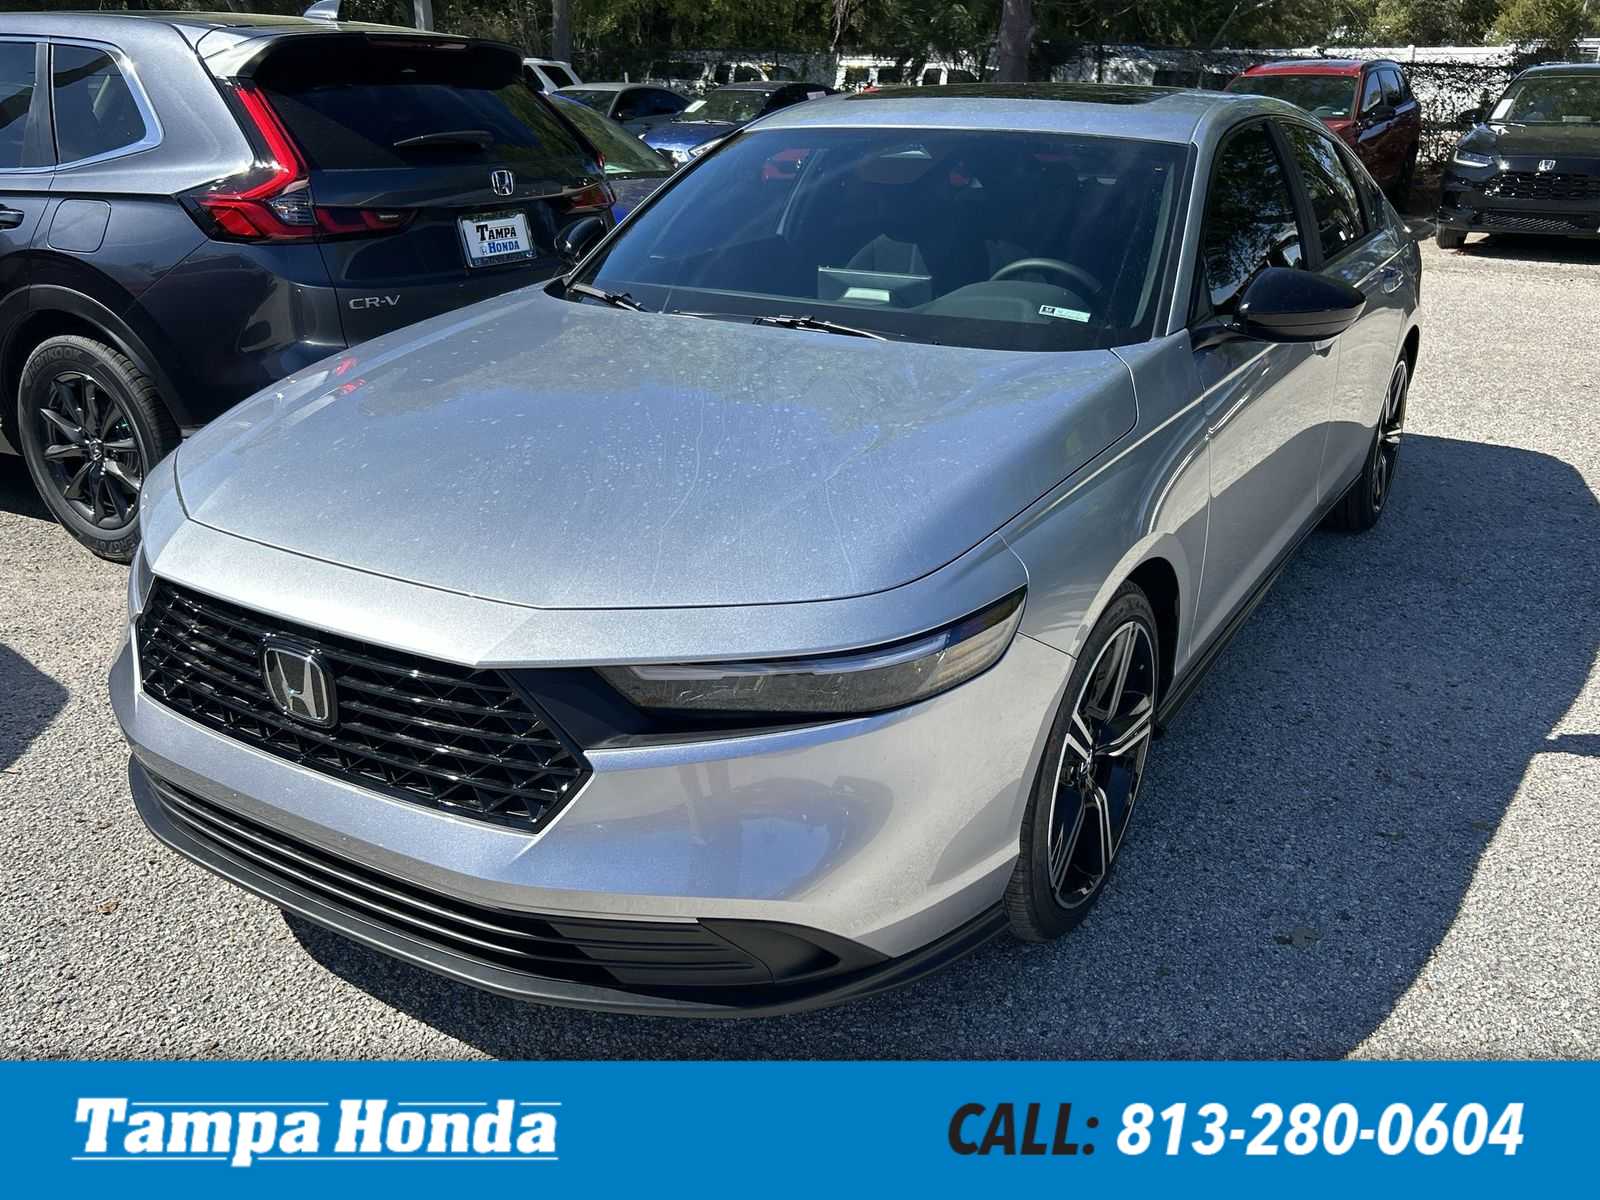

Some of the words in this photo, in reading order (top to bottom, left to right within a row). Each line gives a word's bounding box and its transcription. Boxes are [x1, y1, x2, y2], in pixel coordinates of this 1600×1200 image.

[476, 224, 517, 241] TAMPA
[488, 241, 520, 254] HONDA
[349, 294, 401, 310] CR-V
